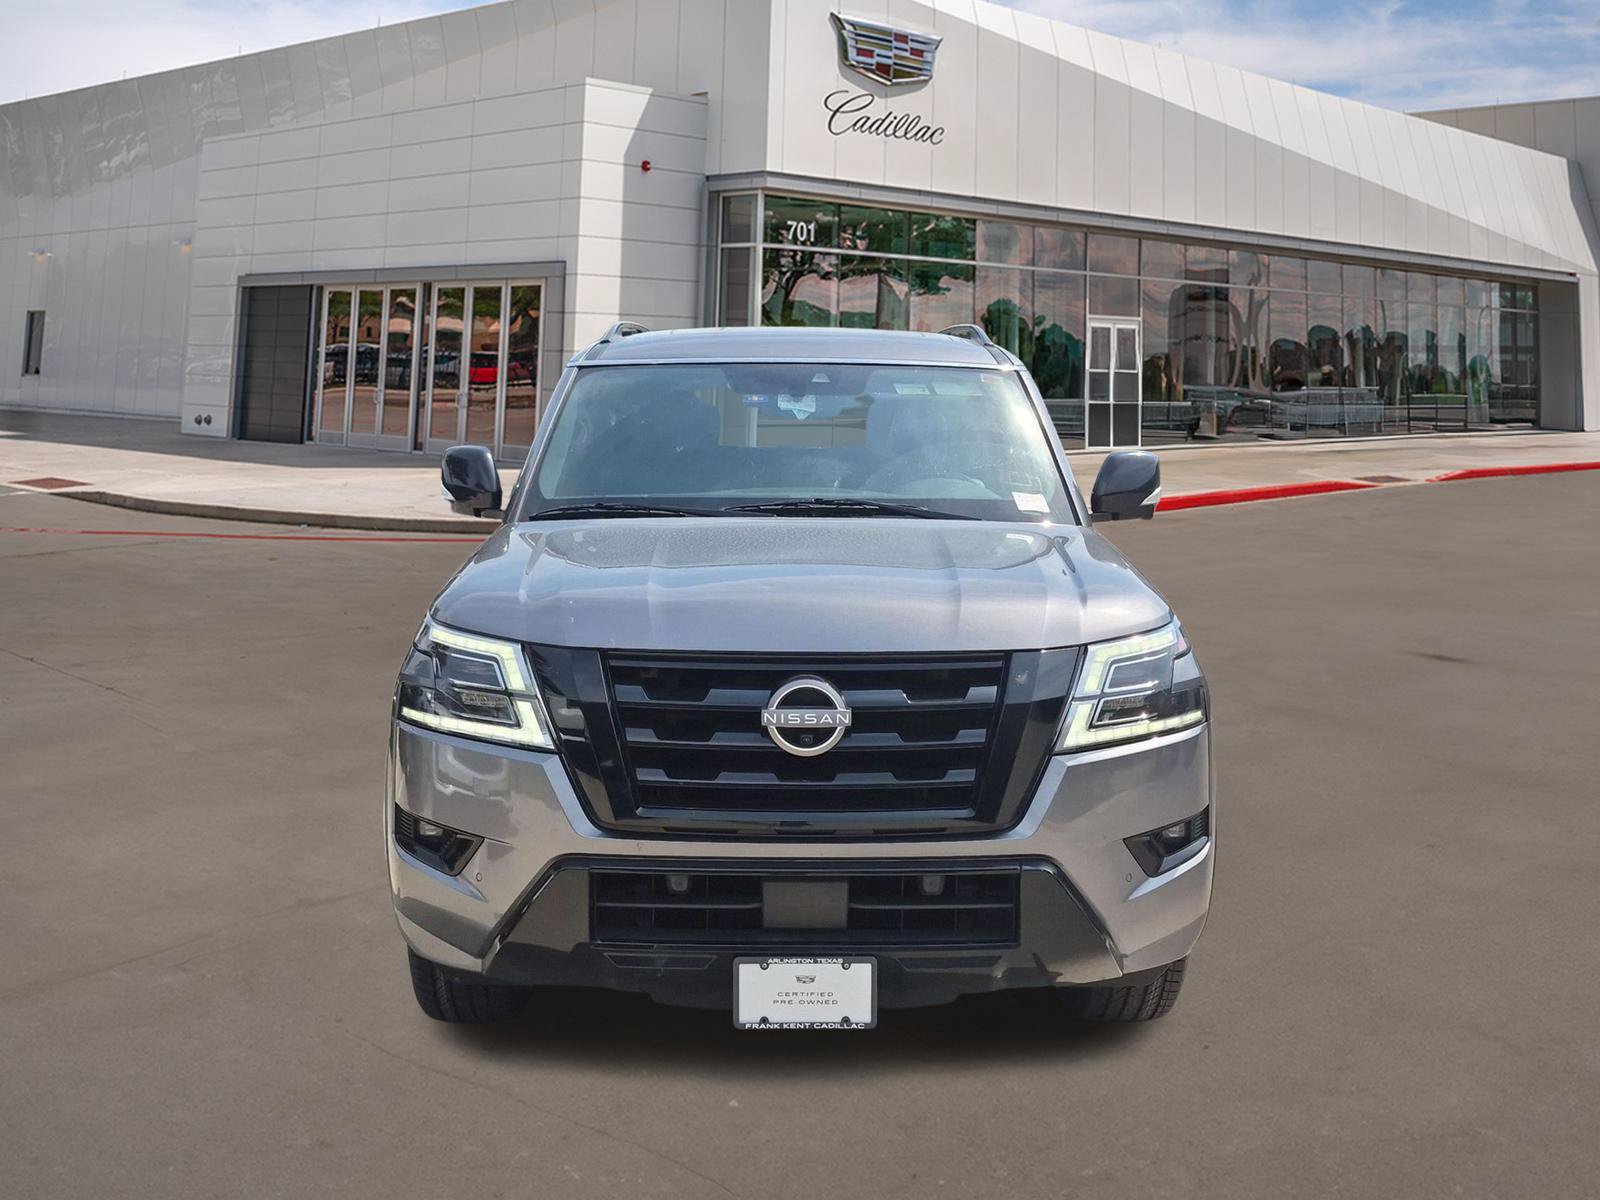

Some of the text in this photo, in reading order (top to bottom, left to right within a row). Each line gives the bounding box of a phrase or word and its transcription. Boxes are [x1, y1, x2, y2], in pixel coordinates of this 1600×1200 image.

[824, 90, 945, 145] Cadillac
[786, 220, 816, 242] 701
[763, 713, 849, 724] NISSAN
[767, 957, 843, 965] ARLINGTON TEXAS
